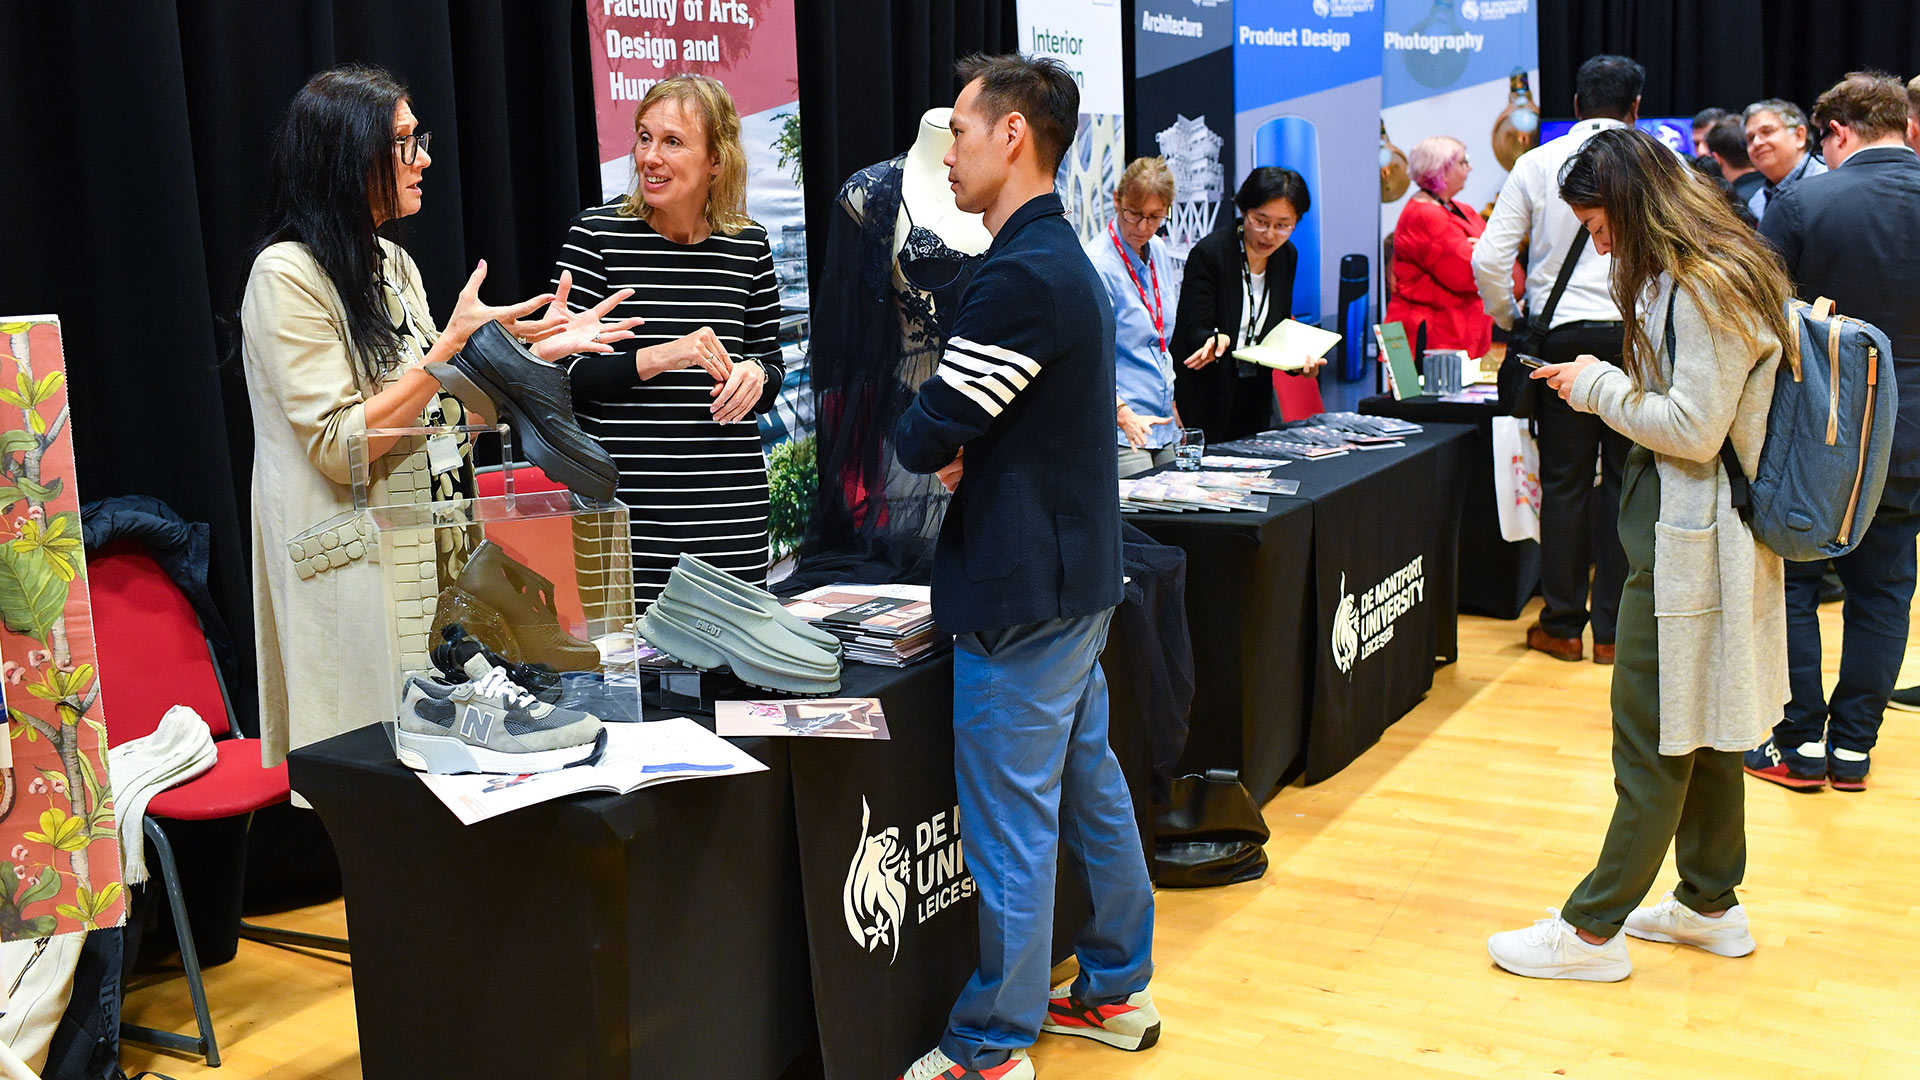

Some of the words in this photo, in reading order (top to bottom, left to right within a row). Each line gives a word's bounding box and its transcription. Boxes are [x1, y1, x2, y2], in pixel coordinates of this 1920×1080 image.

[604, 0, 677, 26] Faculty
[683, 0, 704, 22] of
[709, 0, 754, 29] Arts,
[1142, 10, 1203, 38] Architecture
[606, 29, 677, 68] Design
[683, 35, 720, 62] and
[1032, 26, 1083, 56] Interior
[1239, 25, 1298, 47] Product
[1301, 28, 1350, 52] Design
[1384, 31, 1484, 54] Photography
[1361, 588, 1375, 616] DE
[1375, 554, 1423, 606] MONTFORT
[1361, 576, 1425, 642] UNIVERSITY
[916, 810, 947, 856] DE
[916, 839, 963, 895] UNI
